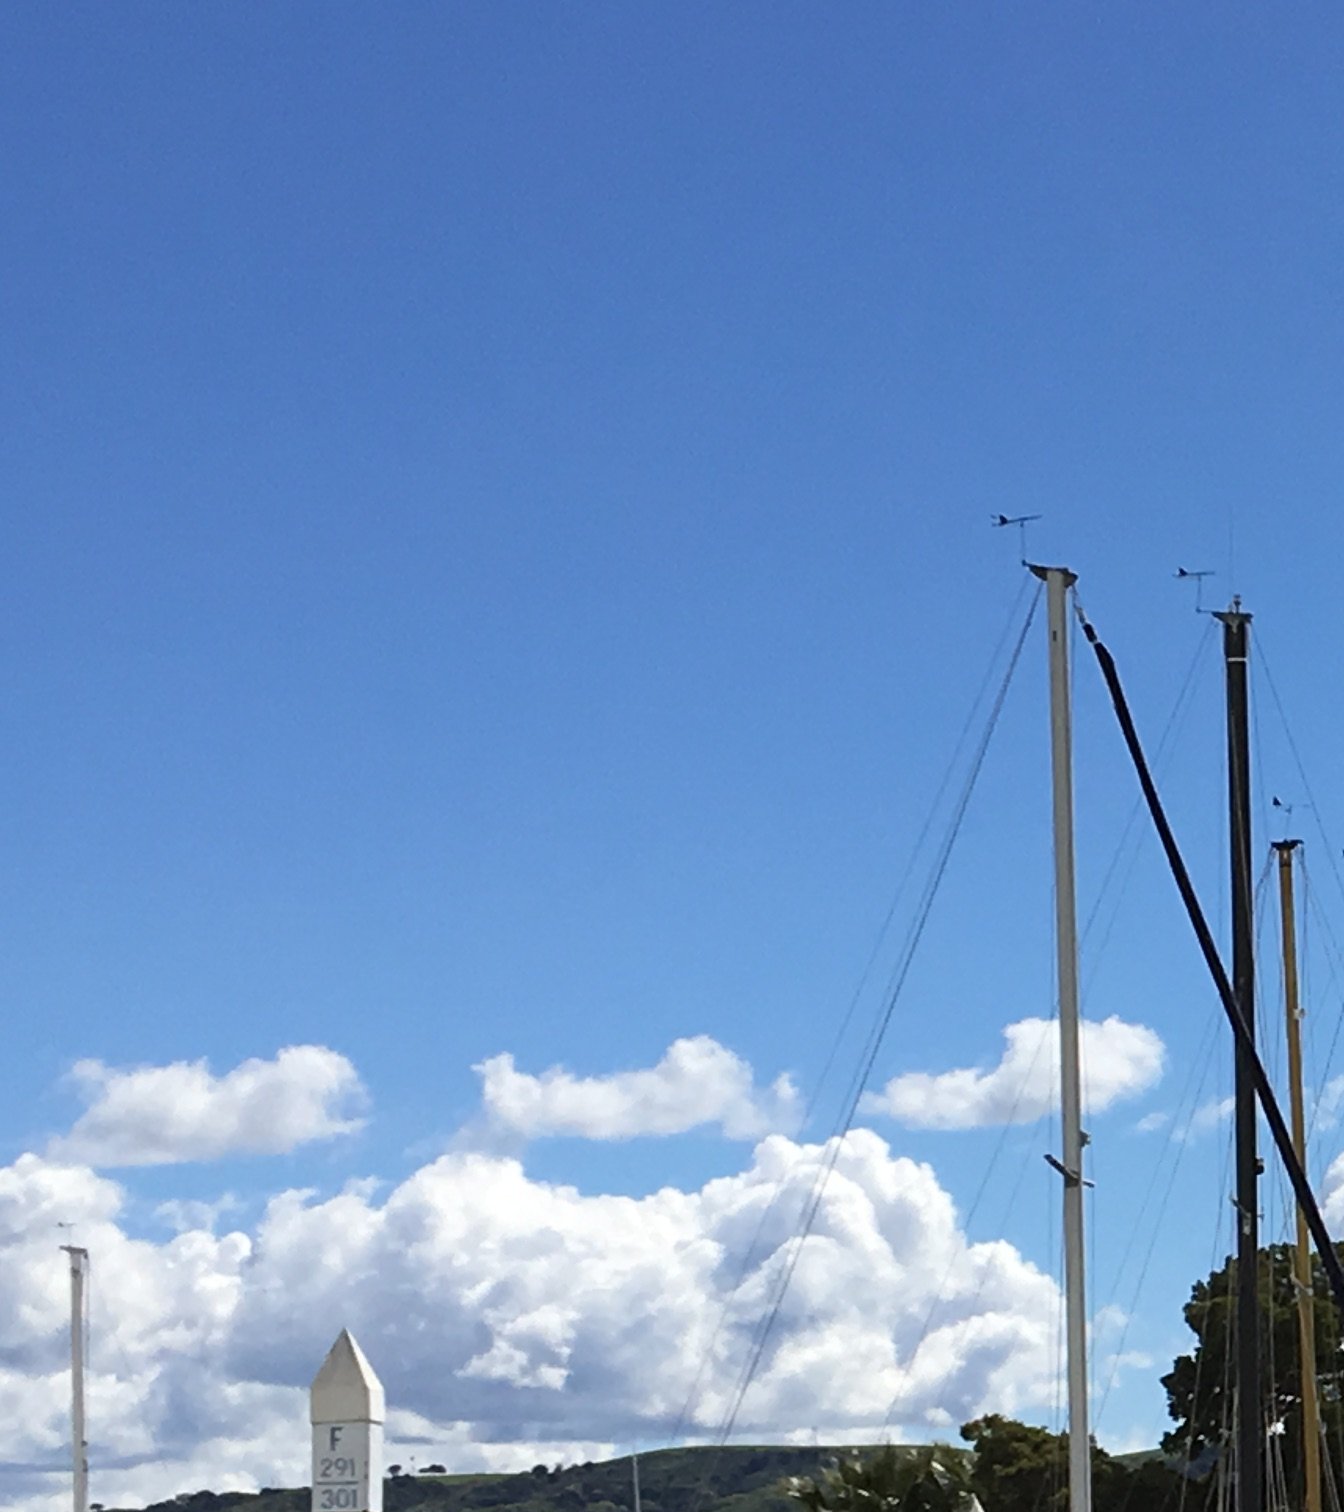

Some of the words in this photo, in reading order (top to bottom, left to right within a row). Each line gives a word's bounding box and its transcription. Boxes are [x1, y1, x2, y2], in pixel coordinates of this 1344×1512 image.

[330, 1427, 343, 1451] F
[320, 1457, 355, 1478] 291
[321, 1488, 358, 1509] 301
